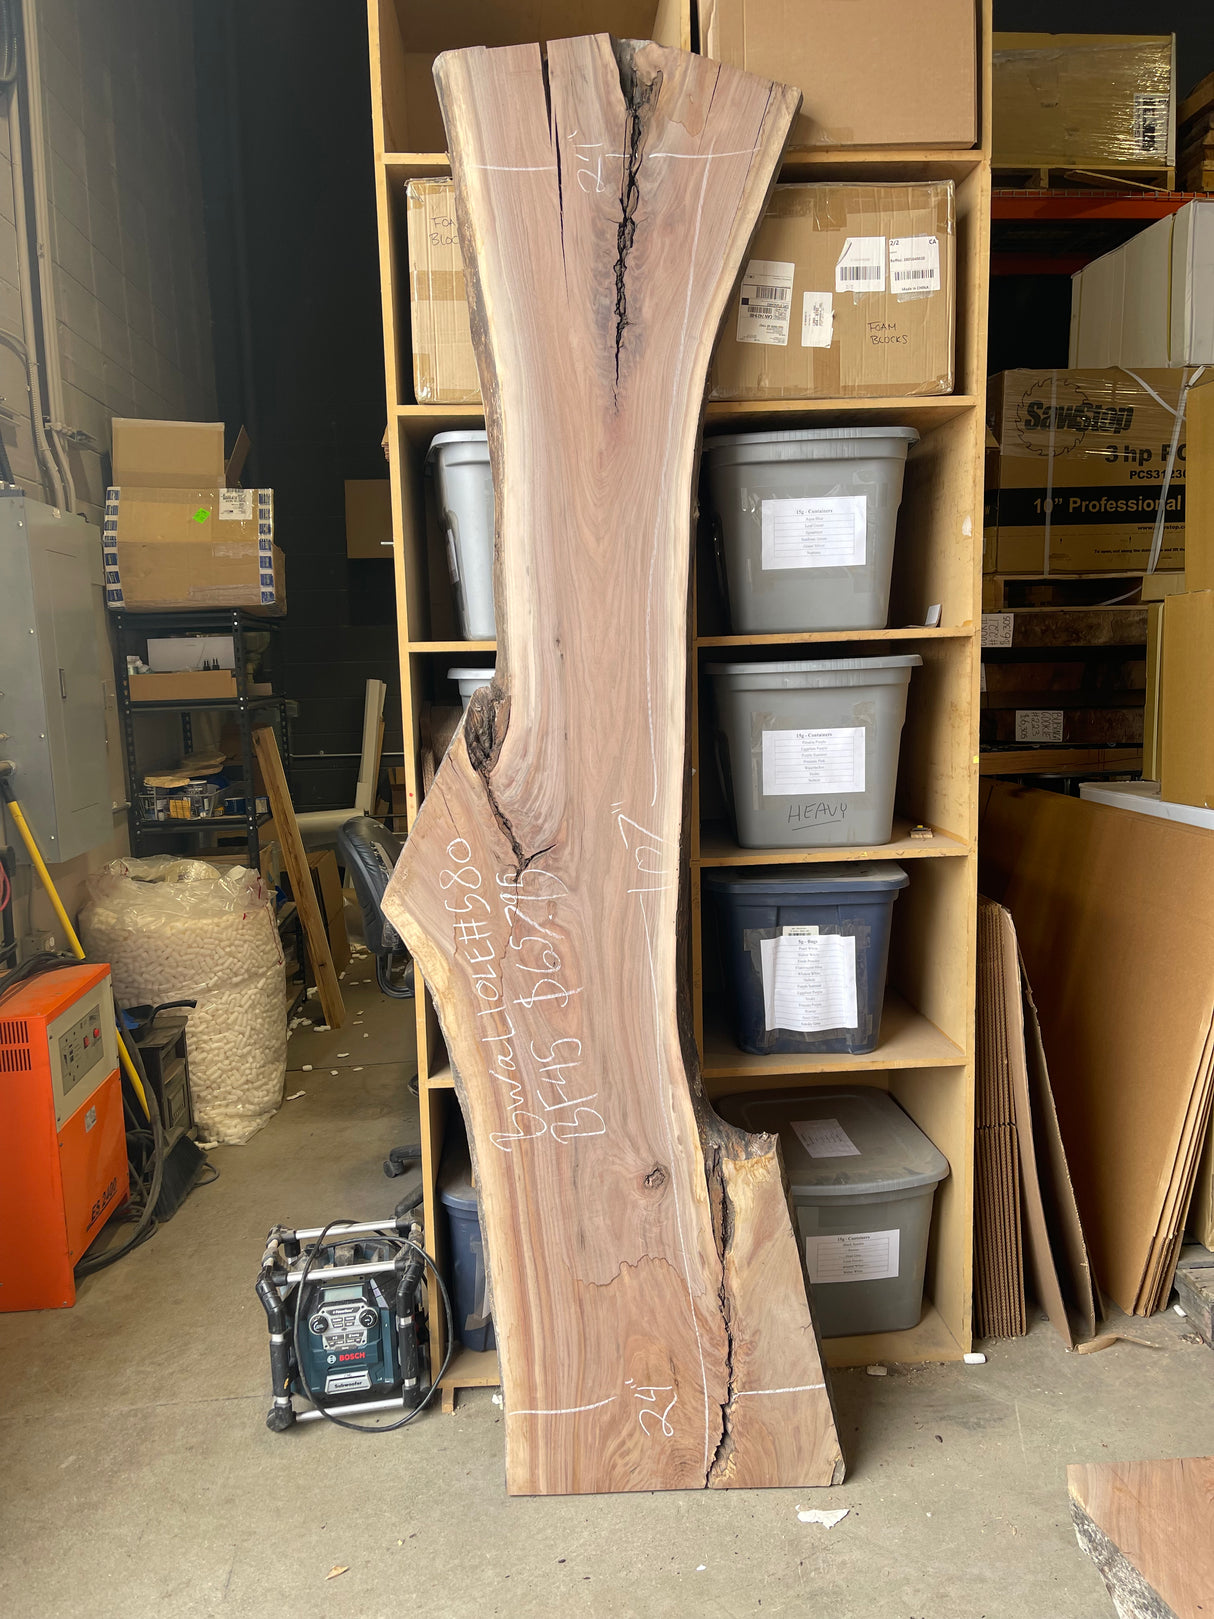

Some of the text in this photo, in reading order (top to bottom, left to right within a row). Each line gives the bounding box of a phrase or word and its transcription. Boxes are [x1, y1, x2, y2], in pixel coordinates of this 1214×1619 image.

[889, 238, 937, 247] 2/2 CA
[867, 321, 897, 331] FOAM
[869, 334, 908, 345] BLOCKS
[1024, 400, 1134, 435] SawStop
[1105, 444, 1118, 463] 3
[1123, 444, 1152, 466] hp
[1068, 495, 1181, 513] Professional
[787, 802, 848, 824] HEAVY
[339, 1352, 366, 1361] BOSCH
[334, 1380, 362, 1389] Subwoofer
